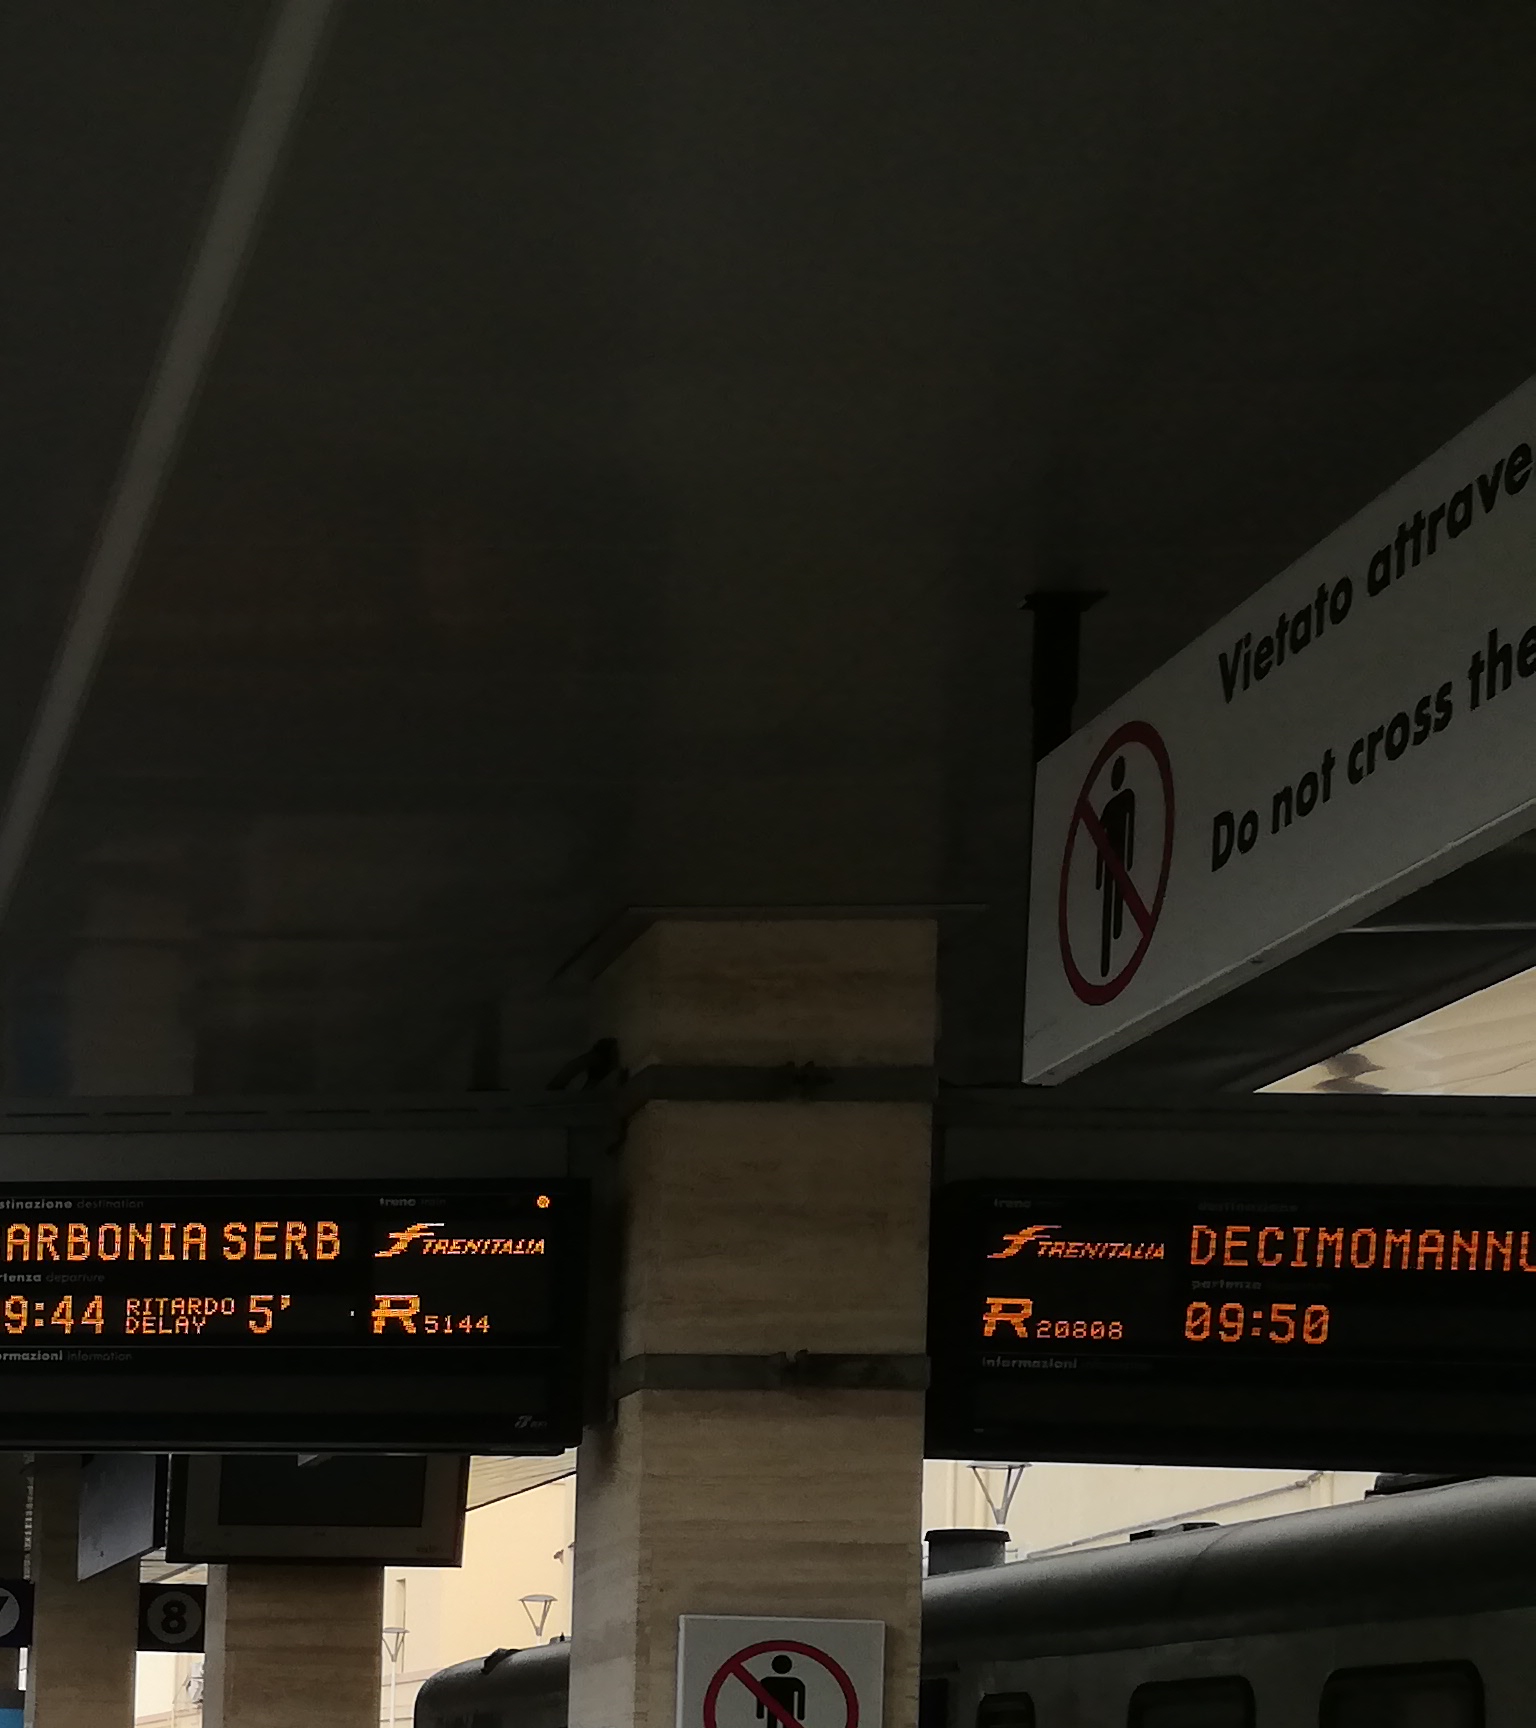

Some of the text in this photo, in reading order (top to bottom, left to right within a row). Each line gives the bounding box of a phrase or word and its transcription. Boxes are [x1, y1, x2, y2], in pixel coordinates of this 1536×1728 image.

[1218, 442, 1534, 704] Vietato attrave
[1212, 625, 1536, 872] Do not cross the
[221, 1220, 341, 1262] SERB
[422, 1238, 546, 1255] TRENITALIA
[1036, 1240, 1166, 1260] TRENITALIA
[126, 1296, 235, 1316] RITARDO
[125, 1315, 207, 1335] DELAY
[423, 1314, 491, 1335] 5144
[1036, 1319, 1124, 1340] 20808
[1184, 1301, 1330, 1345] 09:50
[160, 1599, 187, 1634] 8
